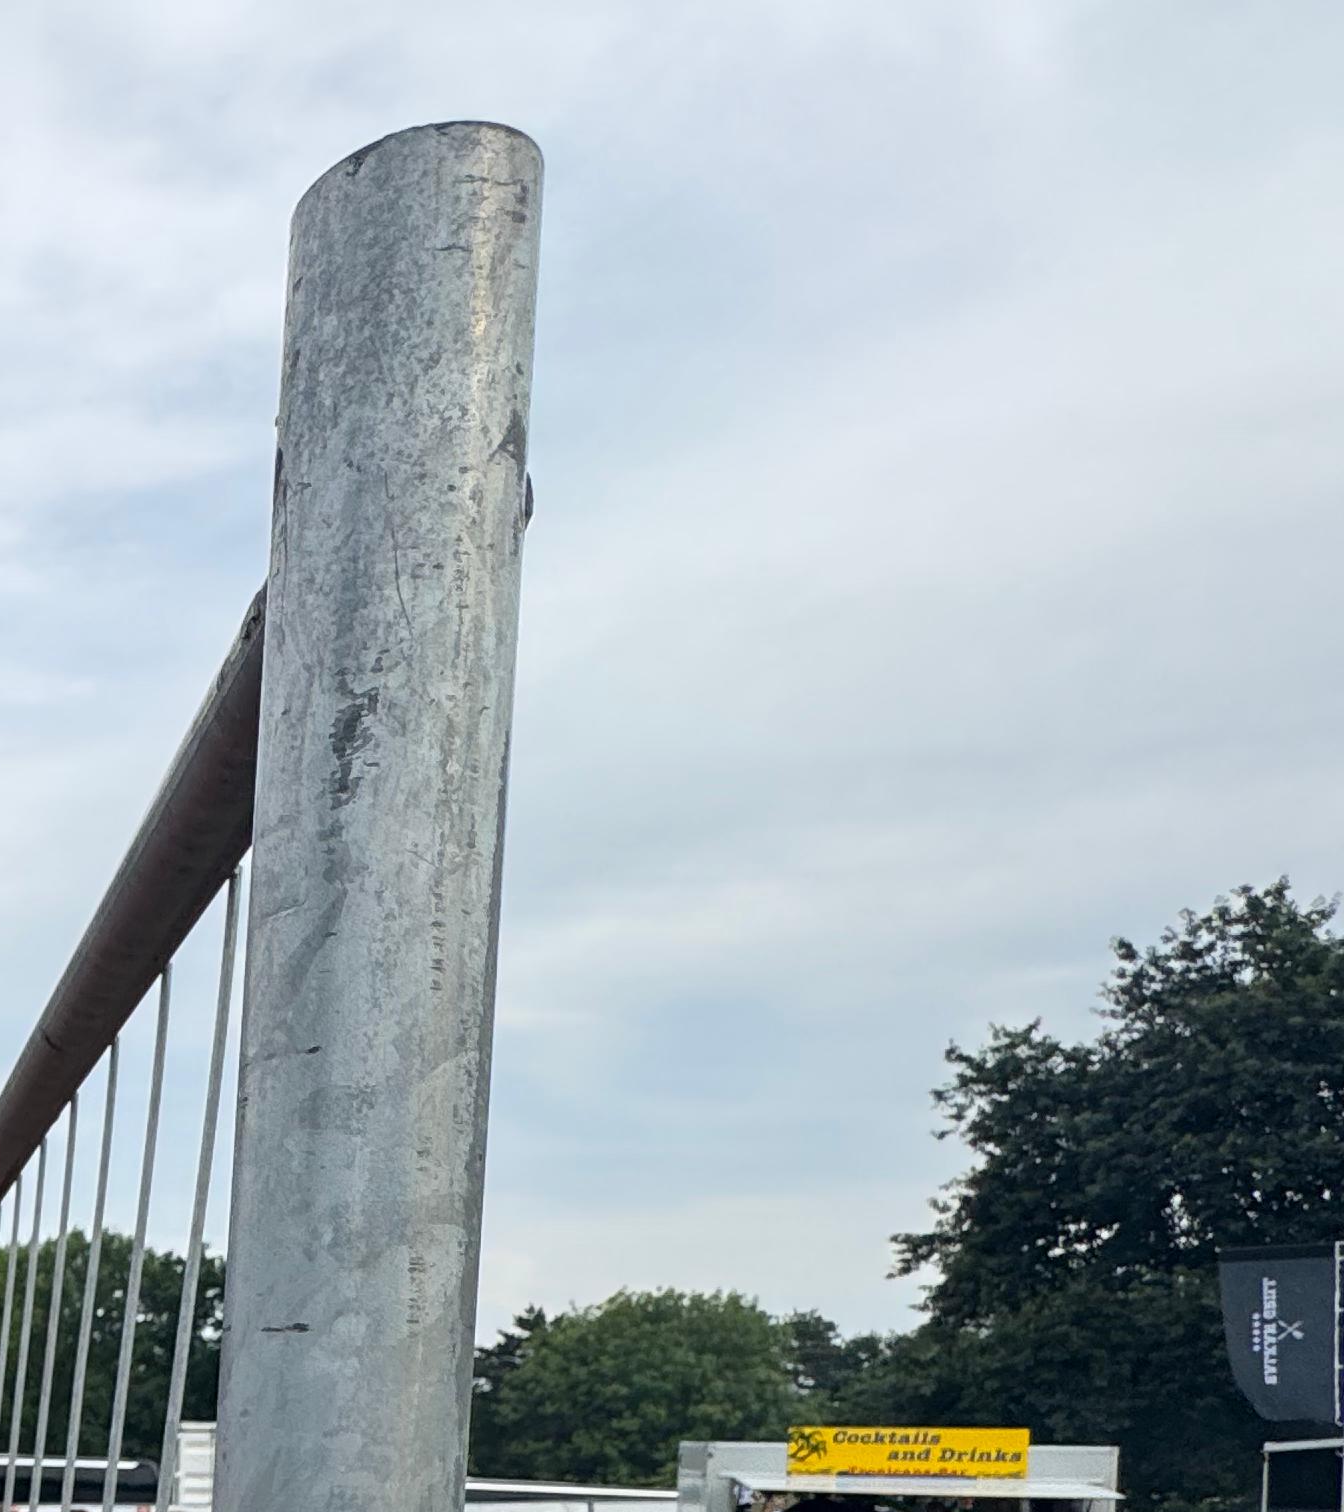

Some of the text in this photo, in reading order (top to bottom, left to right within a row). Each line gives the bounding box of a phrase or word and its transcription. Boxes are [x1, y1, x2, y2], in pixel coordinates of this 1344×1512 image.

[832, 1431, 942, 1445] Cocktails
[887, 1447, 1022, 1463] and Drinks
